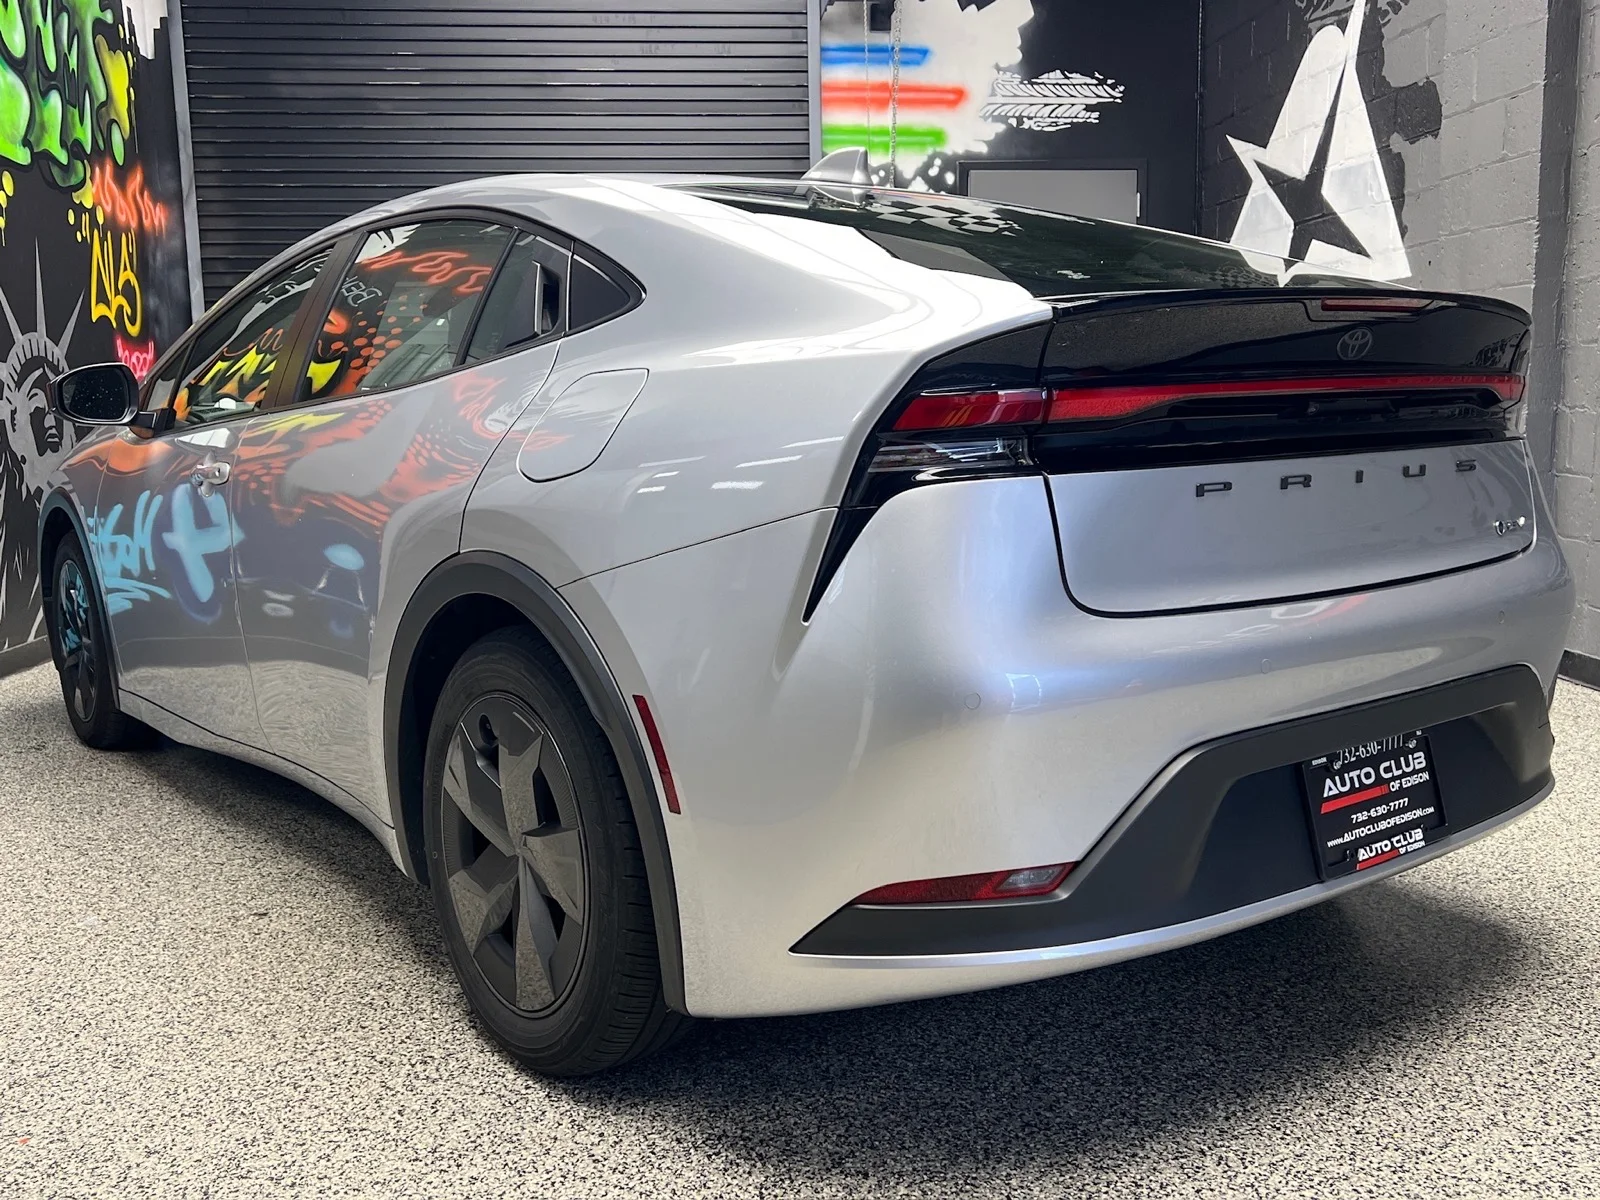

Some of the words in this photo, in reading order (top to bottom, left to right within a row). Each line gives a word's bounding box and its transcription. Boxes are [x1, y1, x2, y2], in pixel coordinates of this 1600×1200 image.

[1195, 459, 1477, 498] PRIUS
[1323, 766, 1376, 798] AUTO
[1379, 751, 1427, 780] CLUB
[1389, 779, 1401, 792] OF
[1402, 771, 1430, 789] EDISON
[1350, 797, 1409, 824] 732-630-7777
[1357, 840, 1391, 861] AUTO
[1391, 828, 1424, 848] CLUB
[1407, 840, 1426, 852] EDISON
